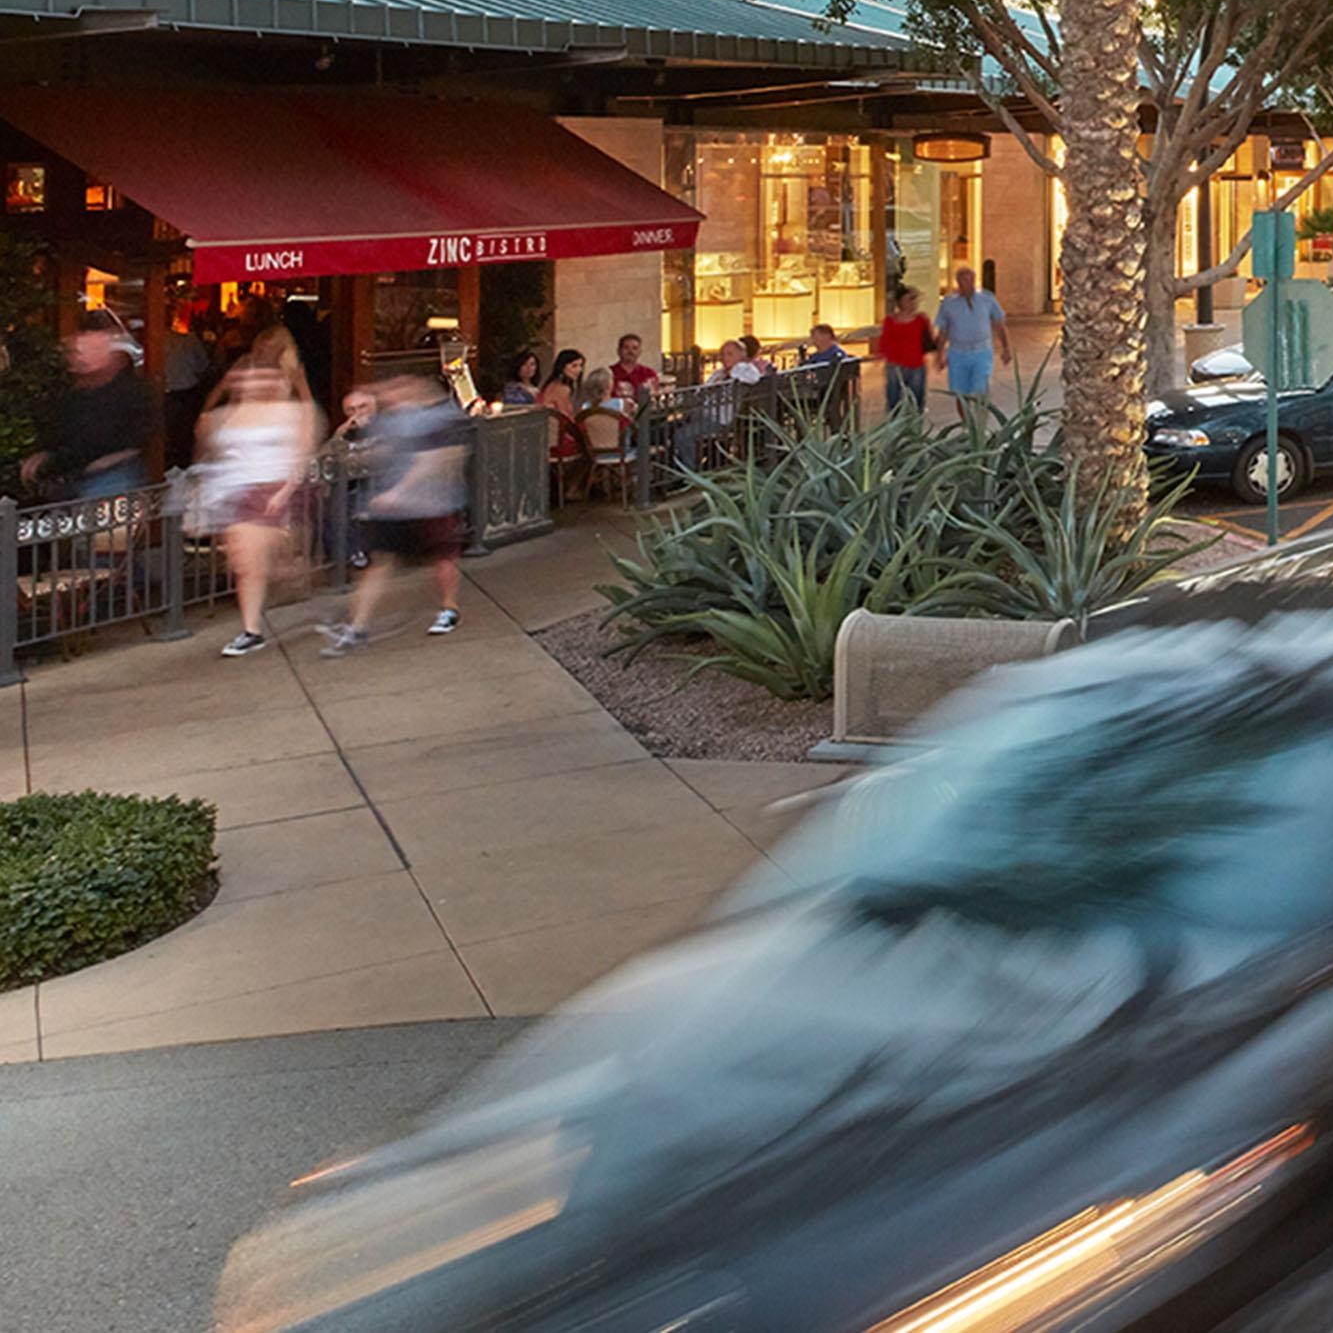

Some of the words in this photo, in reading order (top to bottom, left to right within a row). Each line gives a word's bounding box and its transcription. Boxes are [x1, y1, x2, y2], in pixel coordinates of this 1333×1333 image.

[632, 228, 675, 246] DINNER
[427, 237, 472, 264] ZINC
[476, 236, 546, 256] BISTRO
[245, 251, 303, 271] LUNCH
